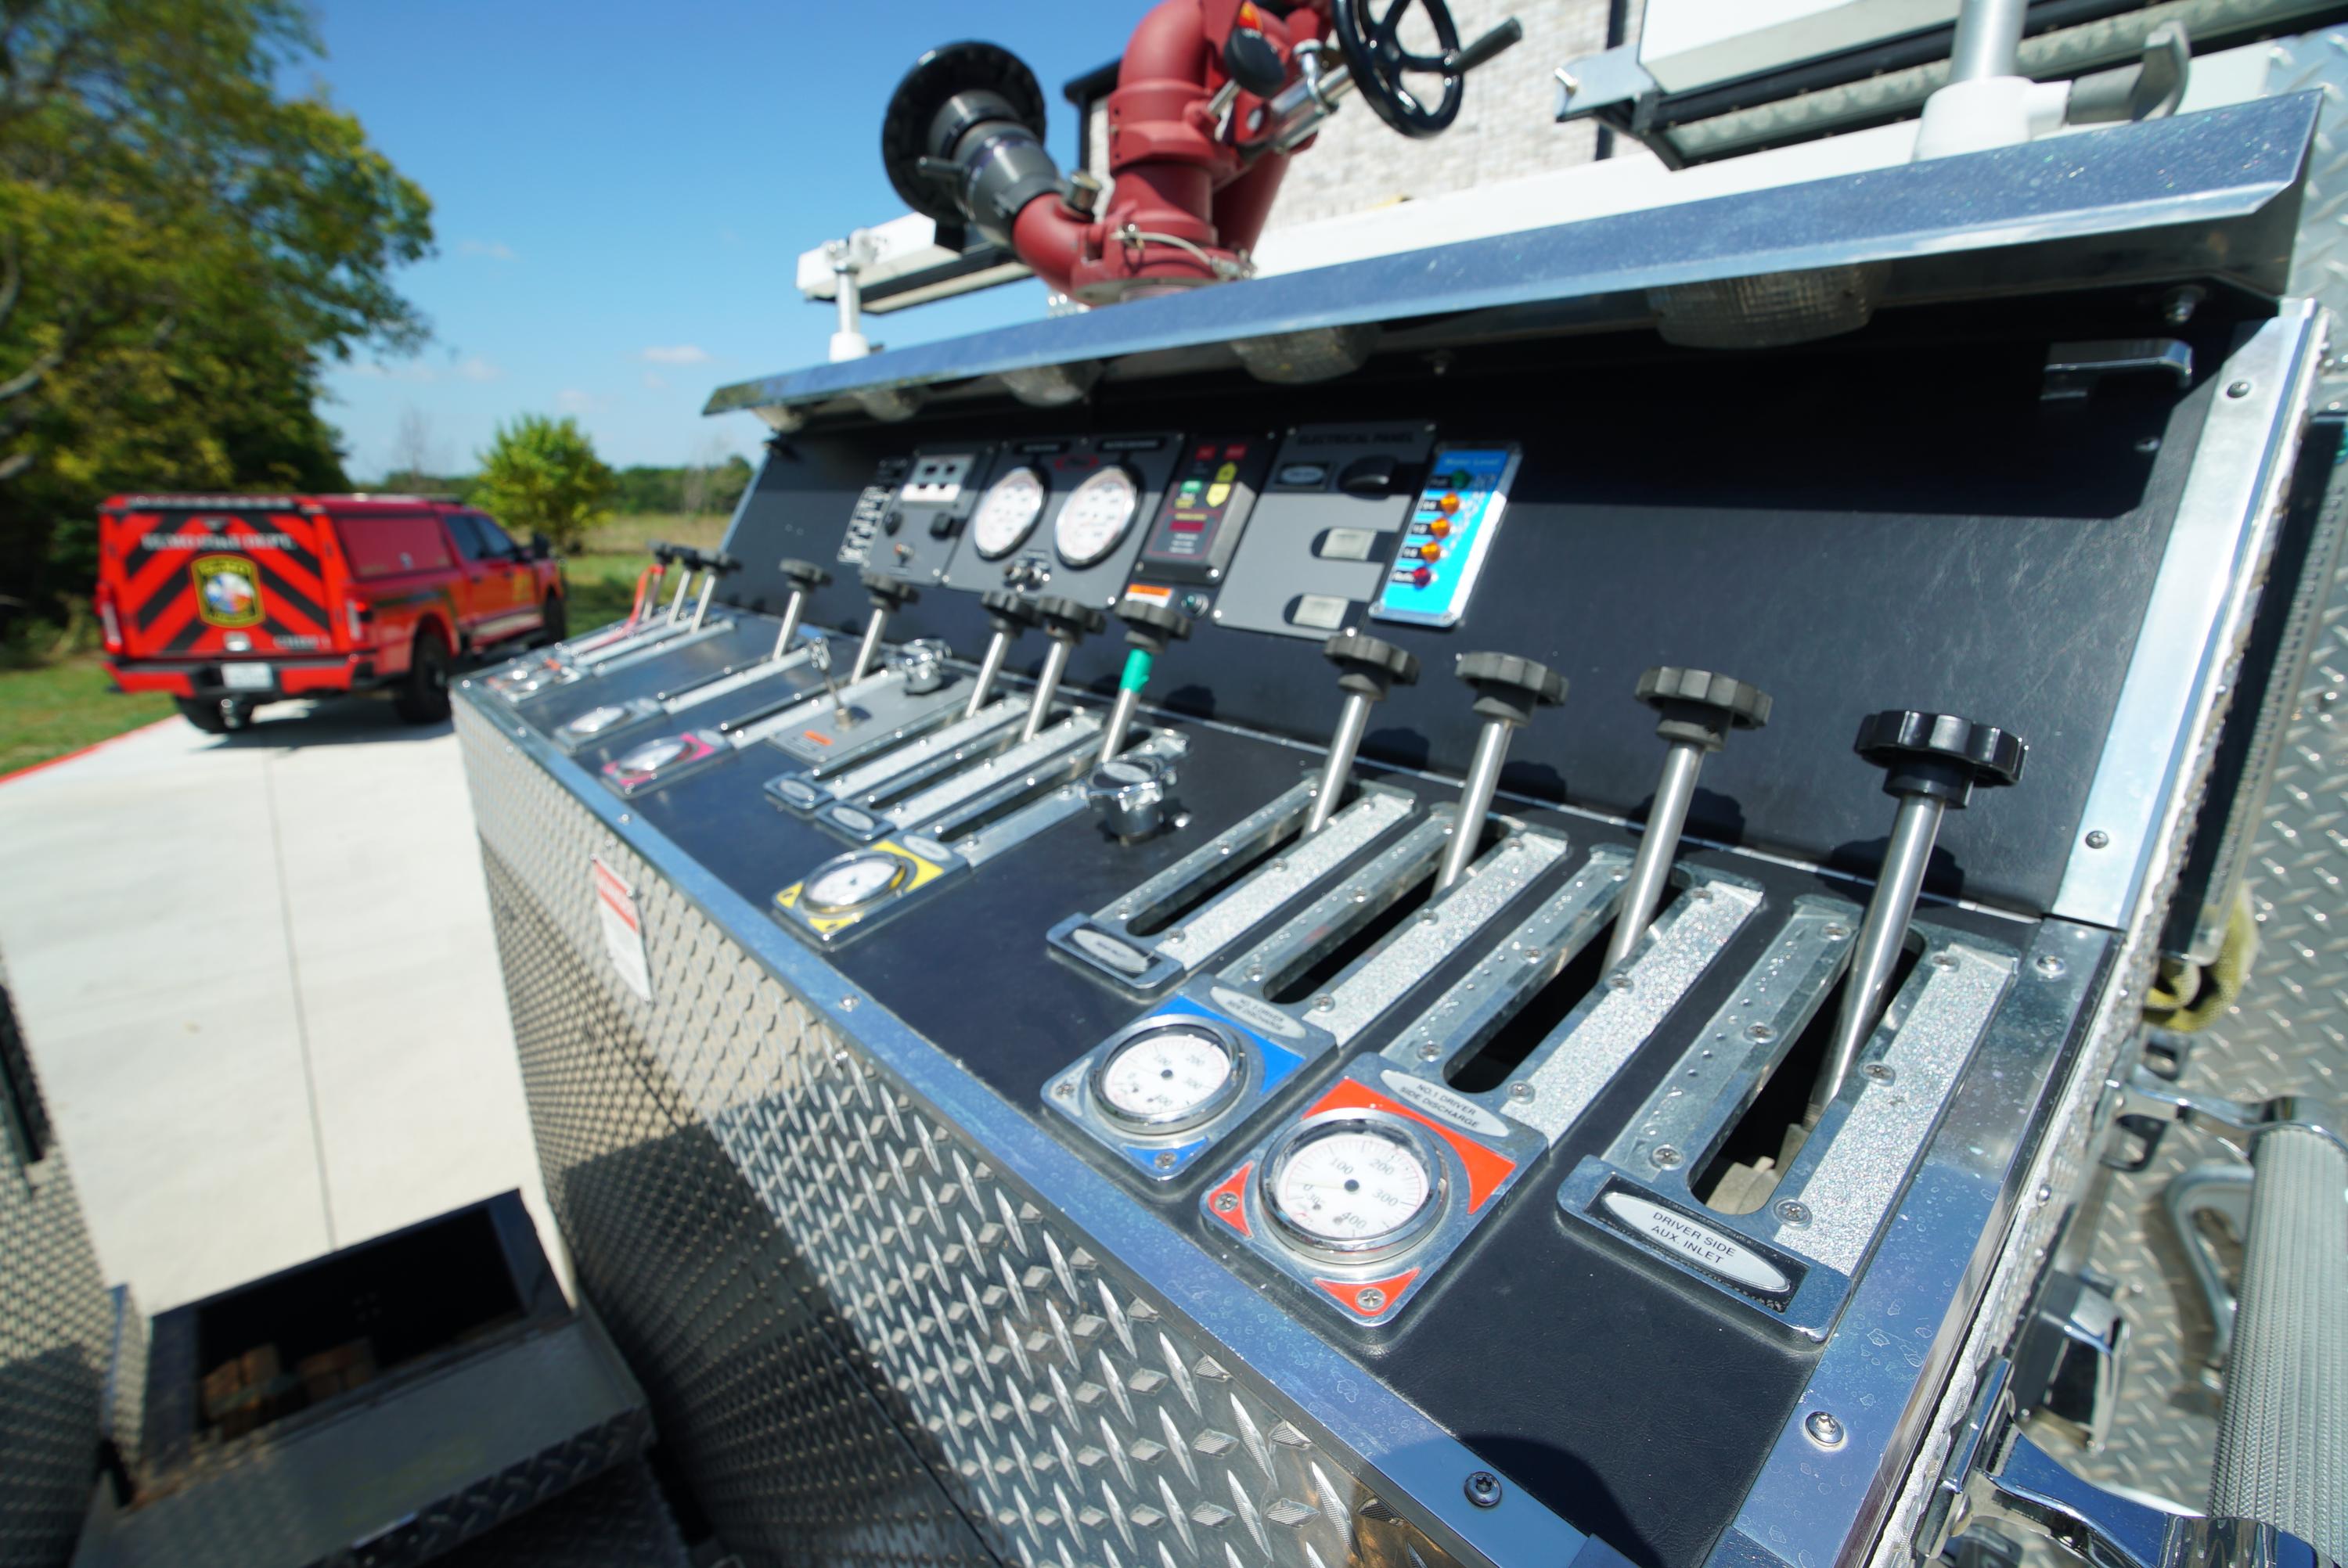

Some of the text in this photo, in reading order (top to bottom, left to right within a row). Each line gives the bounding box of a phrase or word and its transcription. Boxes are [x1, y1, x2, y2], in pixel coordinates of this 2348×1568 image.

[1399, 1086, 1481, 1128] SIDE DISCHARGE
[1439, 1095, 1477, 1116] DRIVER
[1328, 1157, 1354, 1175] 100
[1370, 1157, 1395, 1176] 200
[1371, 1189, 1399, 1207] 300
[1341, 1211, 1368, 1231] 400
[1651, 1225, 1724, 1264] AUX. INLET
[1653, 1212, 1737, 1257] DRIVER SIDE
